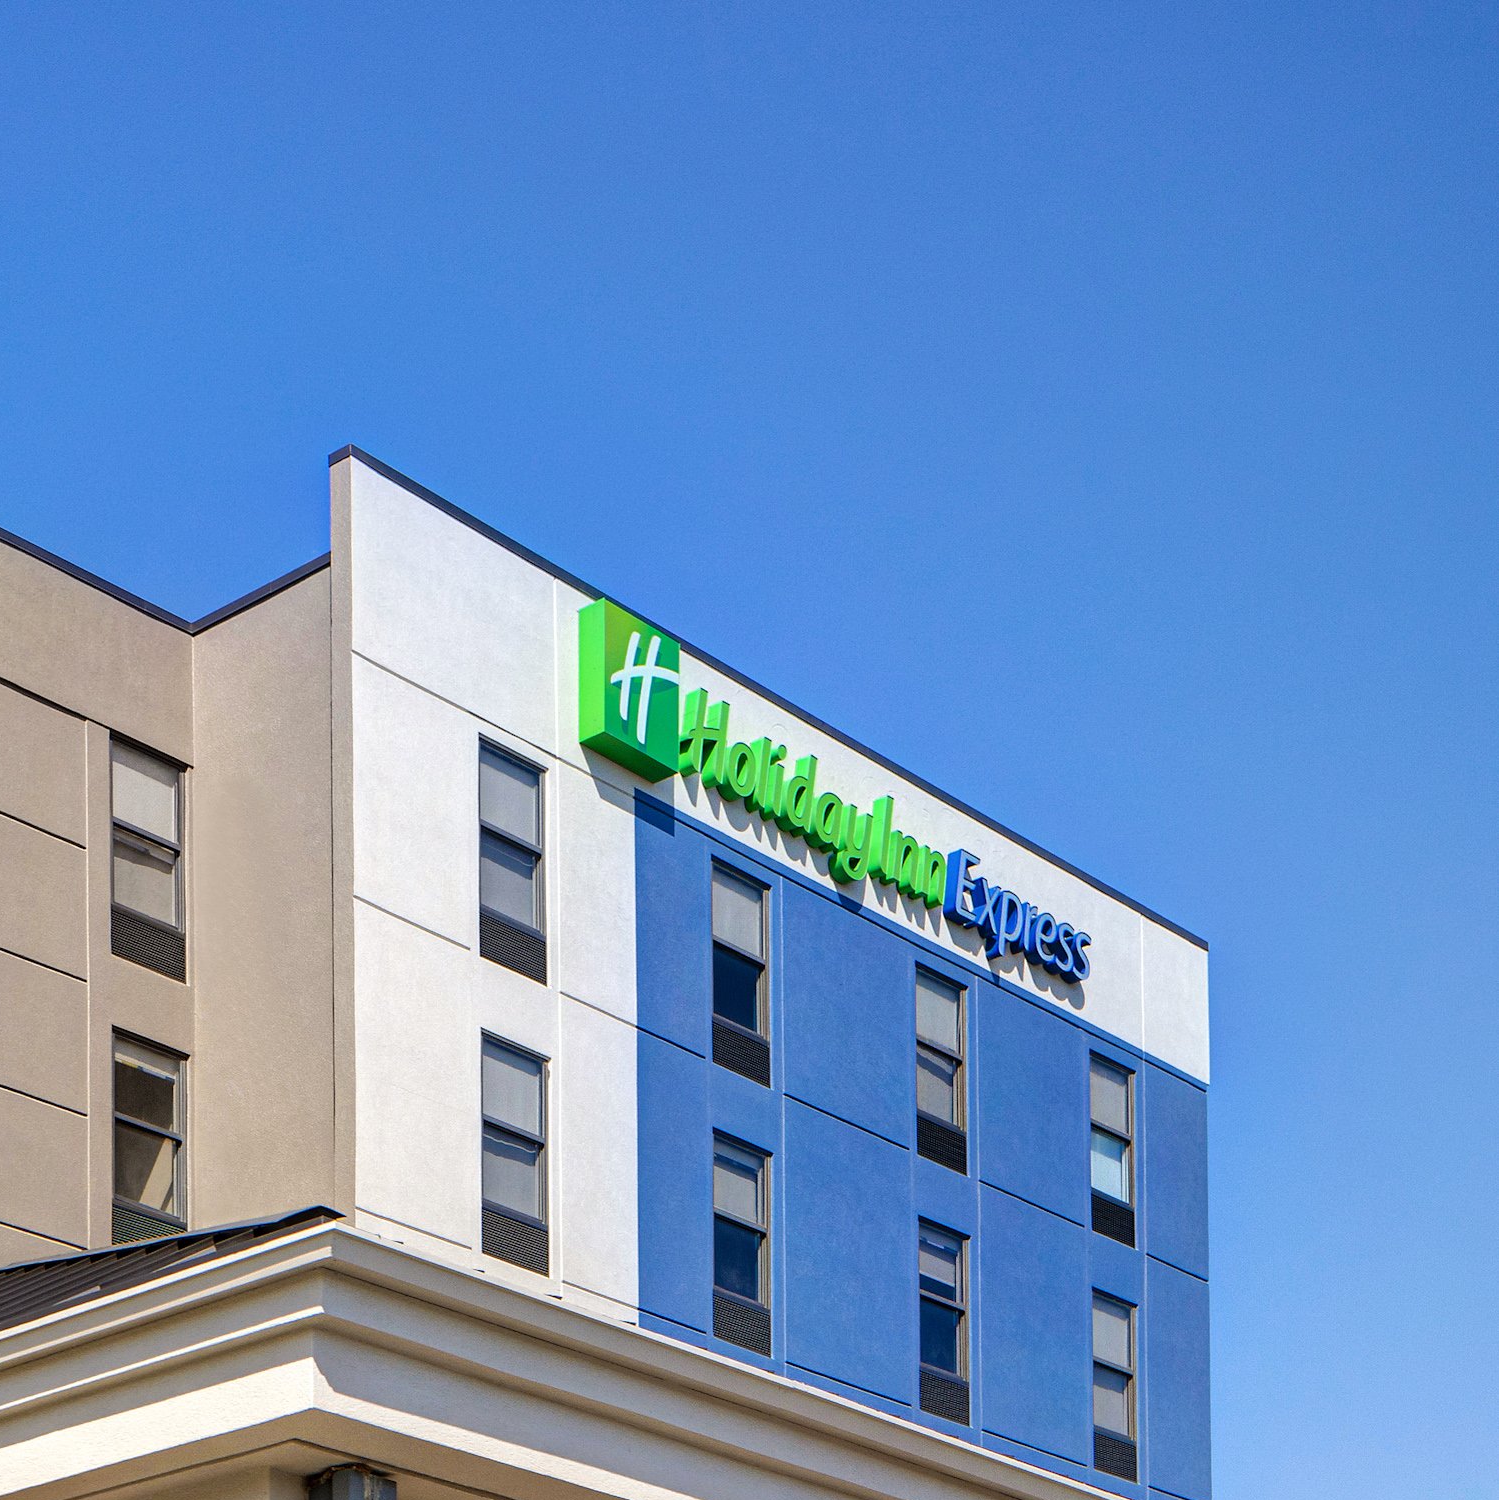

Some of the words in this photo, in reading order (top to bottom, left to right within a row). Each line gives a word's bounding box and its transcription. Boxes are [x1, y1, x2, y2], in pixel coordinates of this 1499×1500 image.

[609, 630, 680, 746] H
[678, 687, 874, 884] Holiday
[868, 795, 946, 908] Inn
[944, 848, 1093, 984] Express
